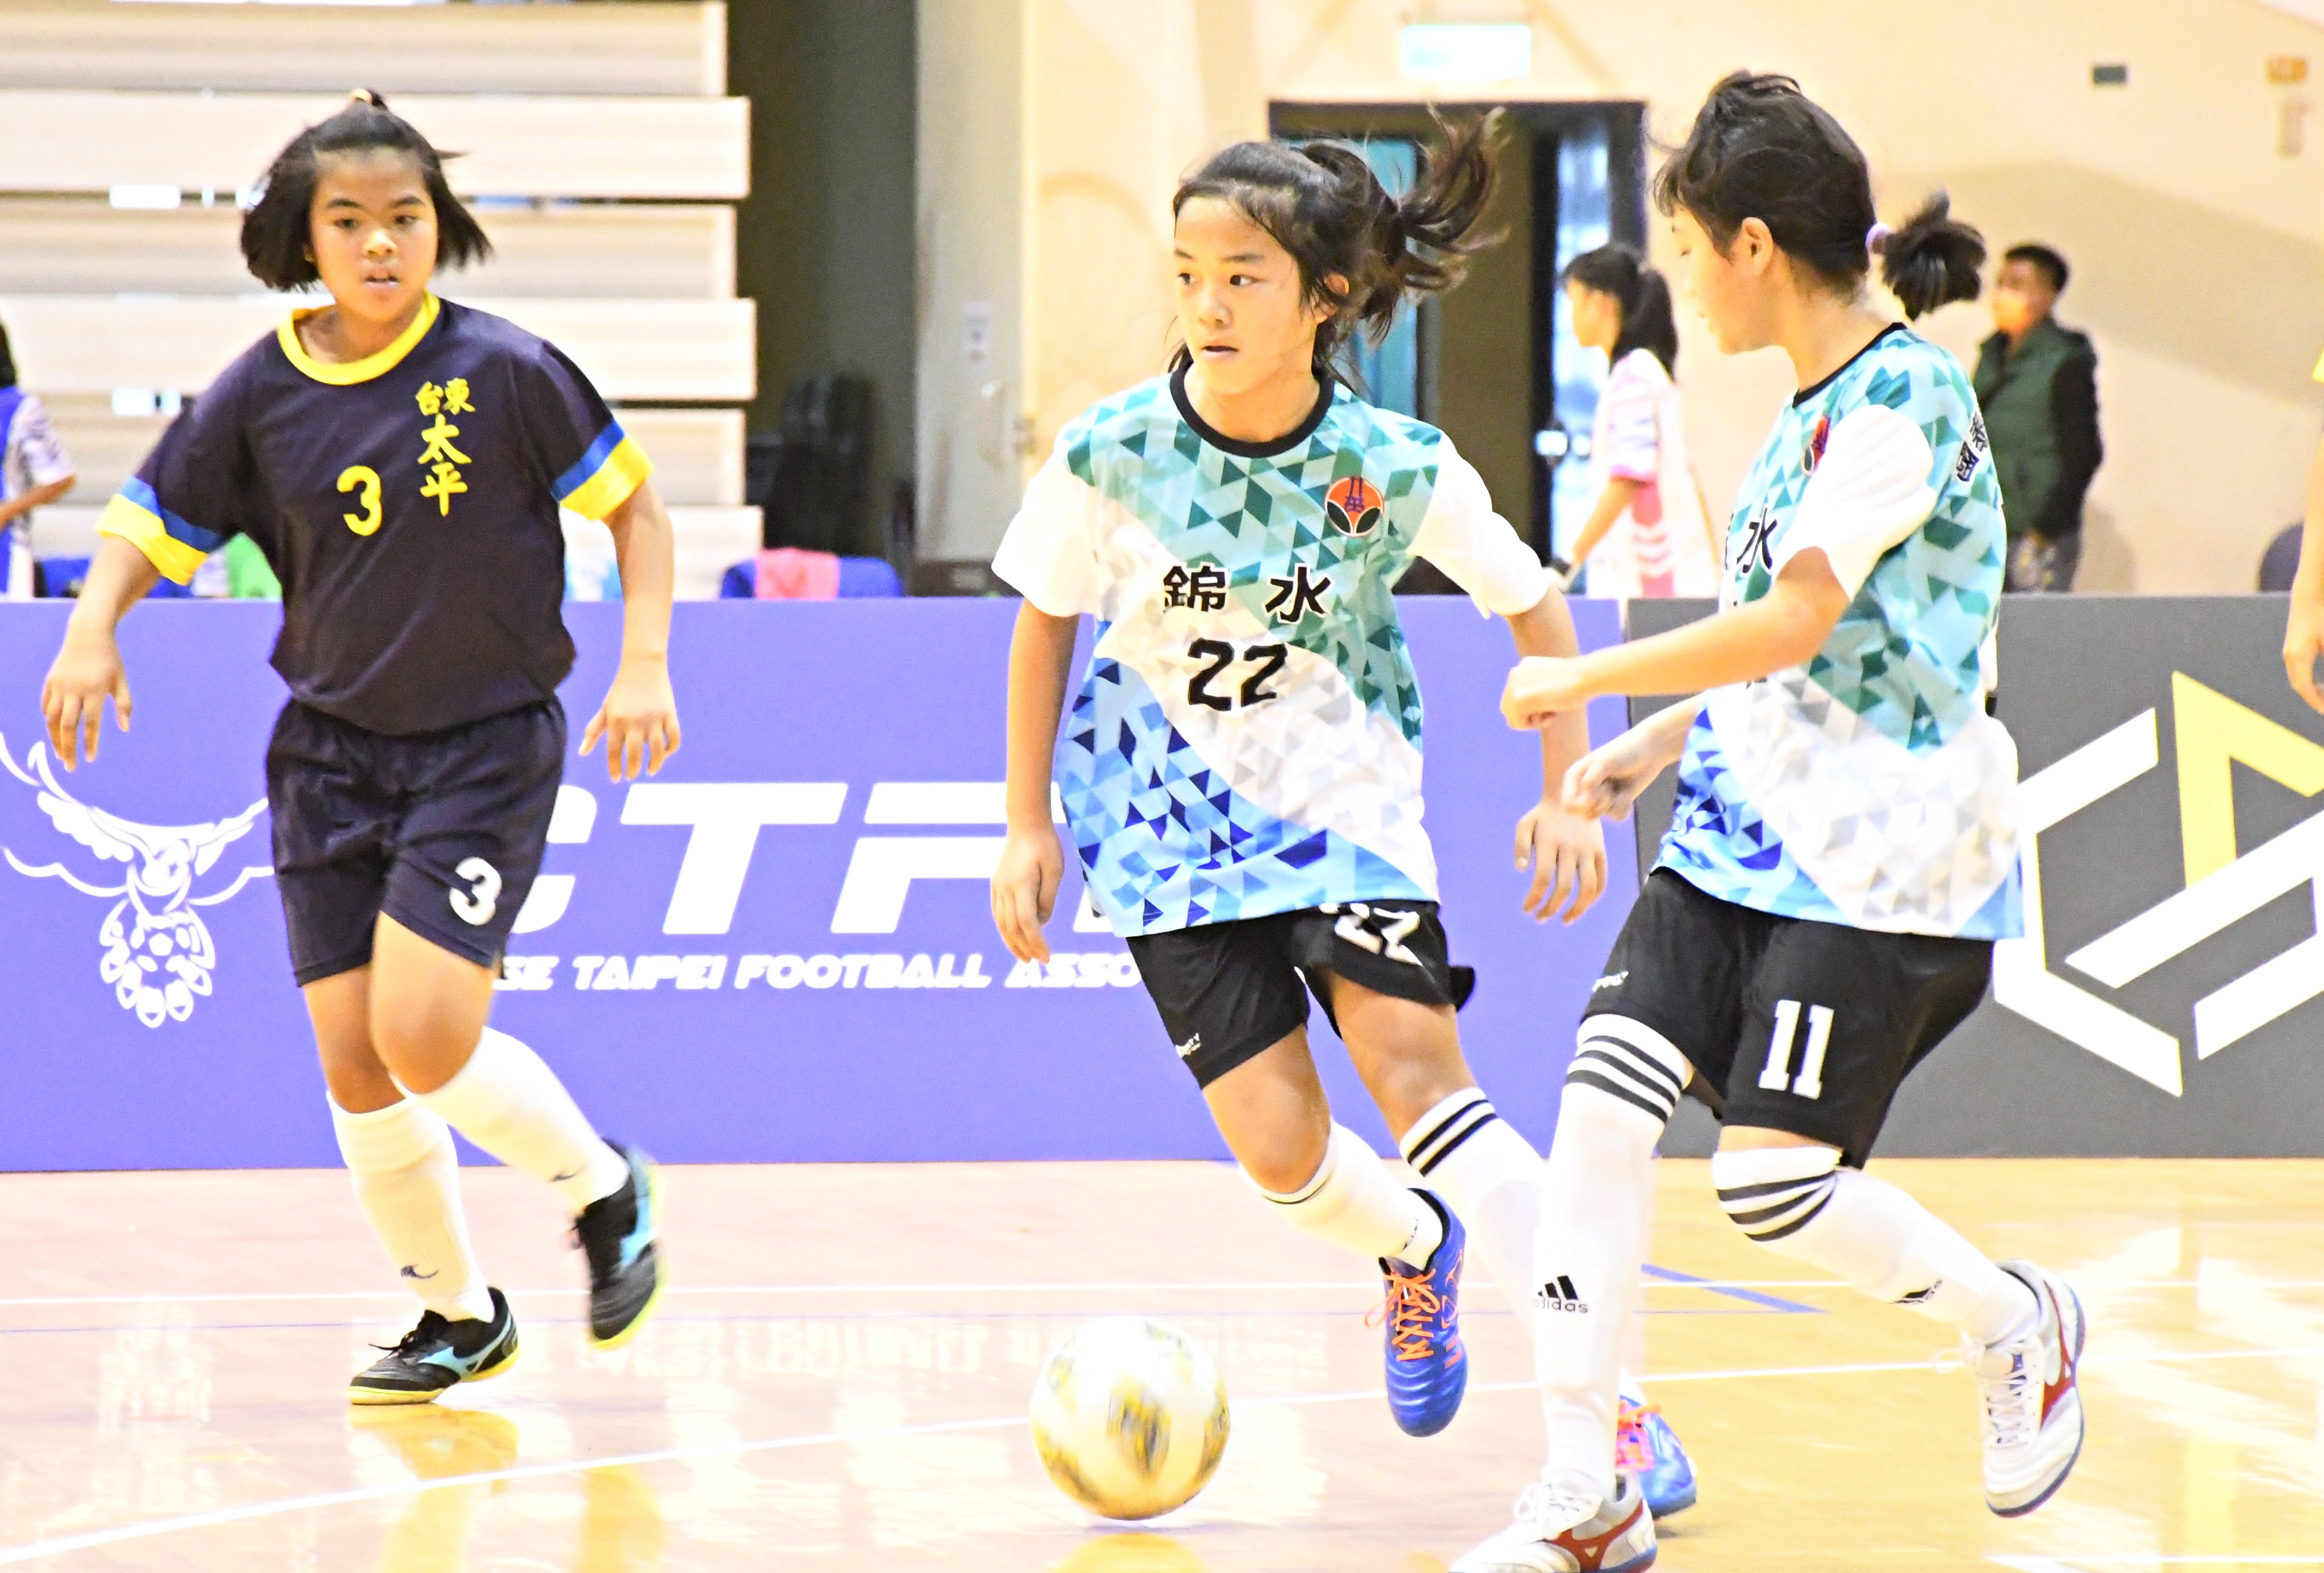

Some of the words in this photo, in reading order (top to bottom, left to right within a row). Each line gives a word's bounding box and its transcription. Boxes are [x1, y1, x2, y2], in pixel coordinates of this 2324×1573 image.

[417, 412, 473, 517] 太平
[336, 465, 382, 536] 3
[1725, 507, 1778, 574] 水
[1187, 637, 1288, 711] 22
[449, 856, 502, 926] 3
[571, 955, 728, 990] TAIPEI
[734, 953, 992, 989] FOOTBALL
[1758, 999, 1834, 1100] 11
